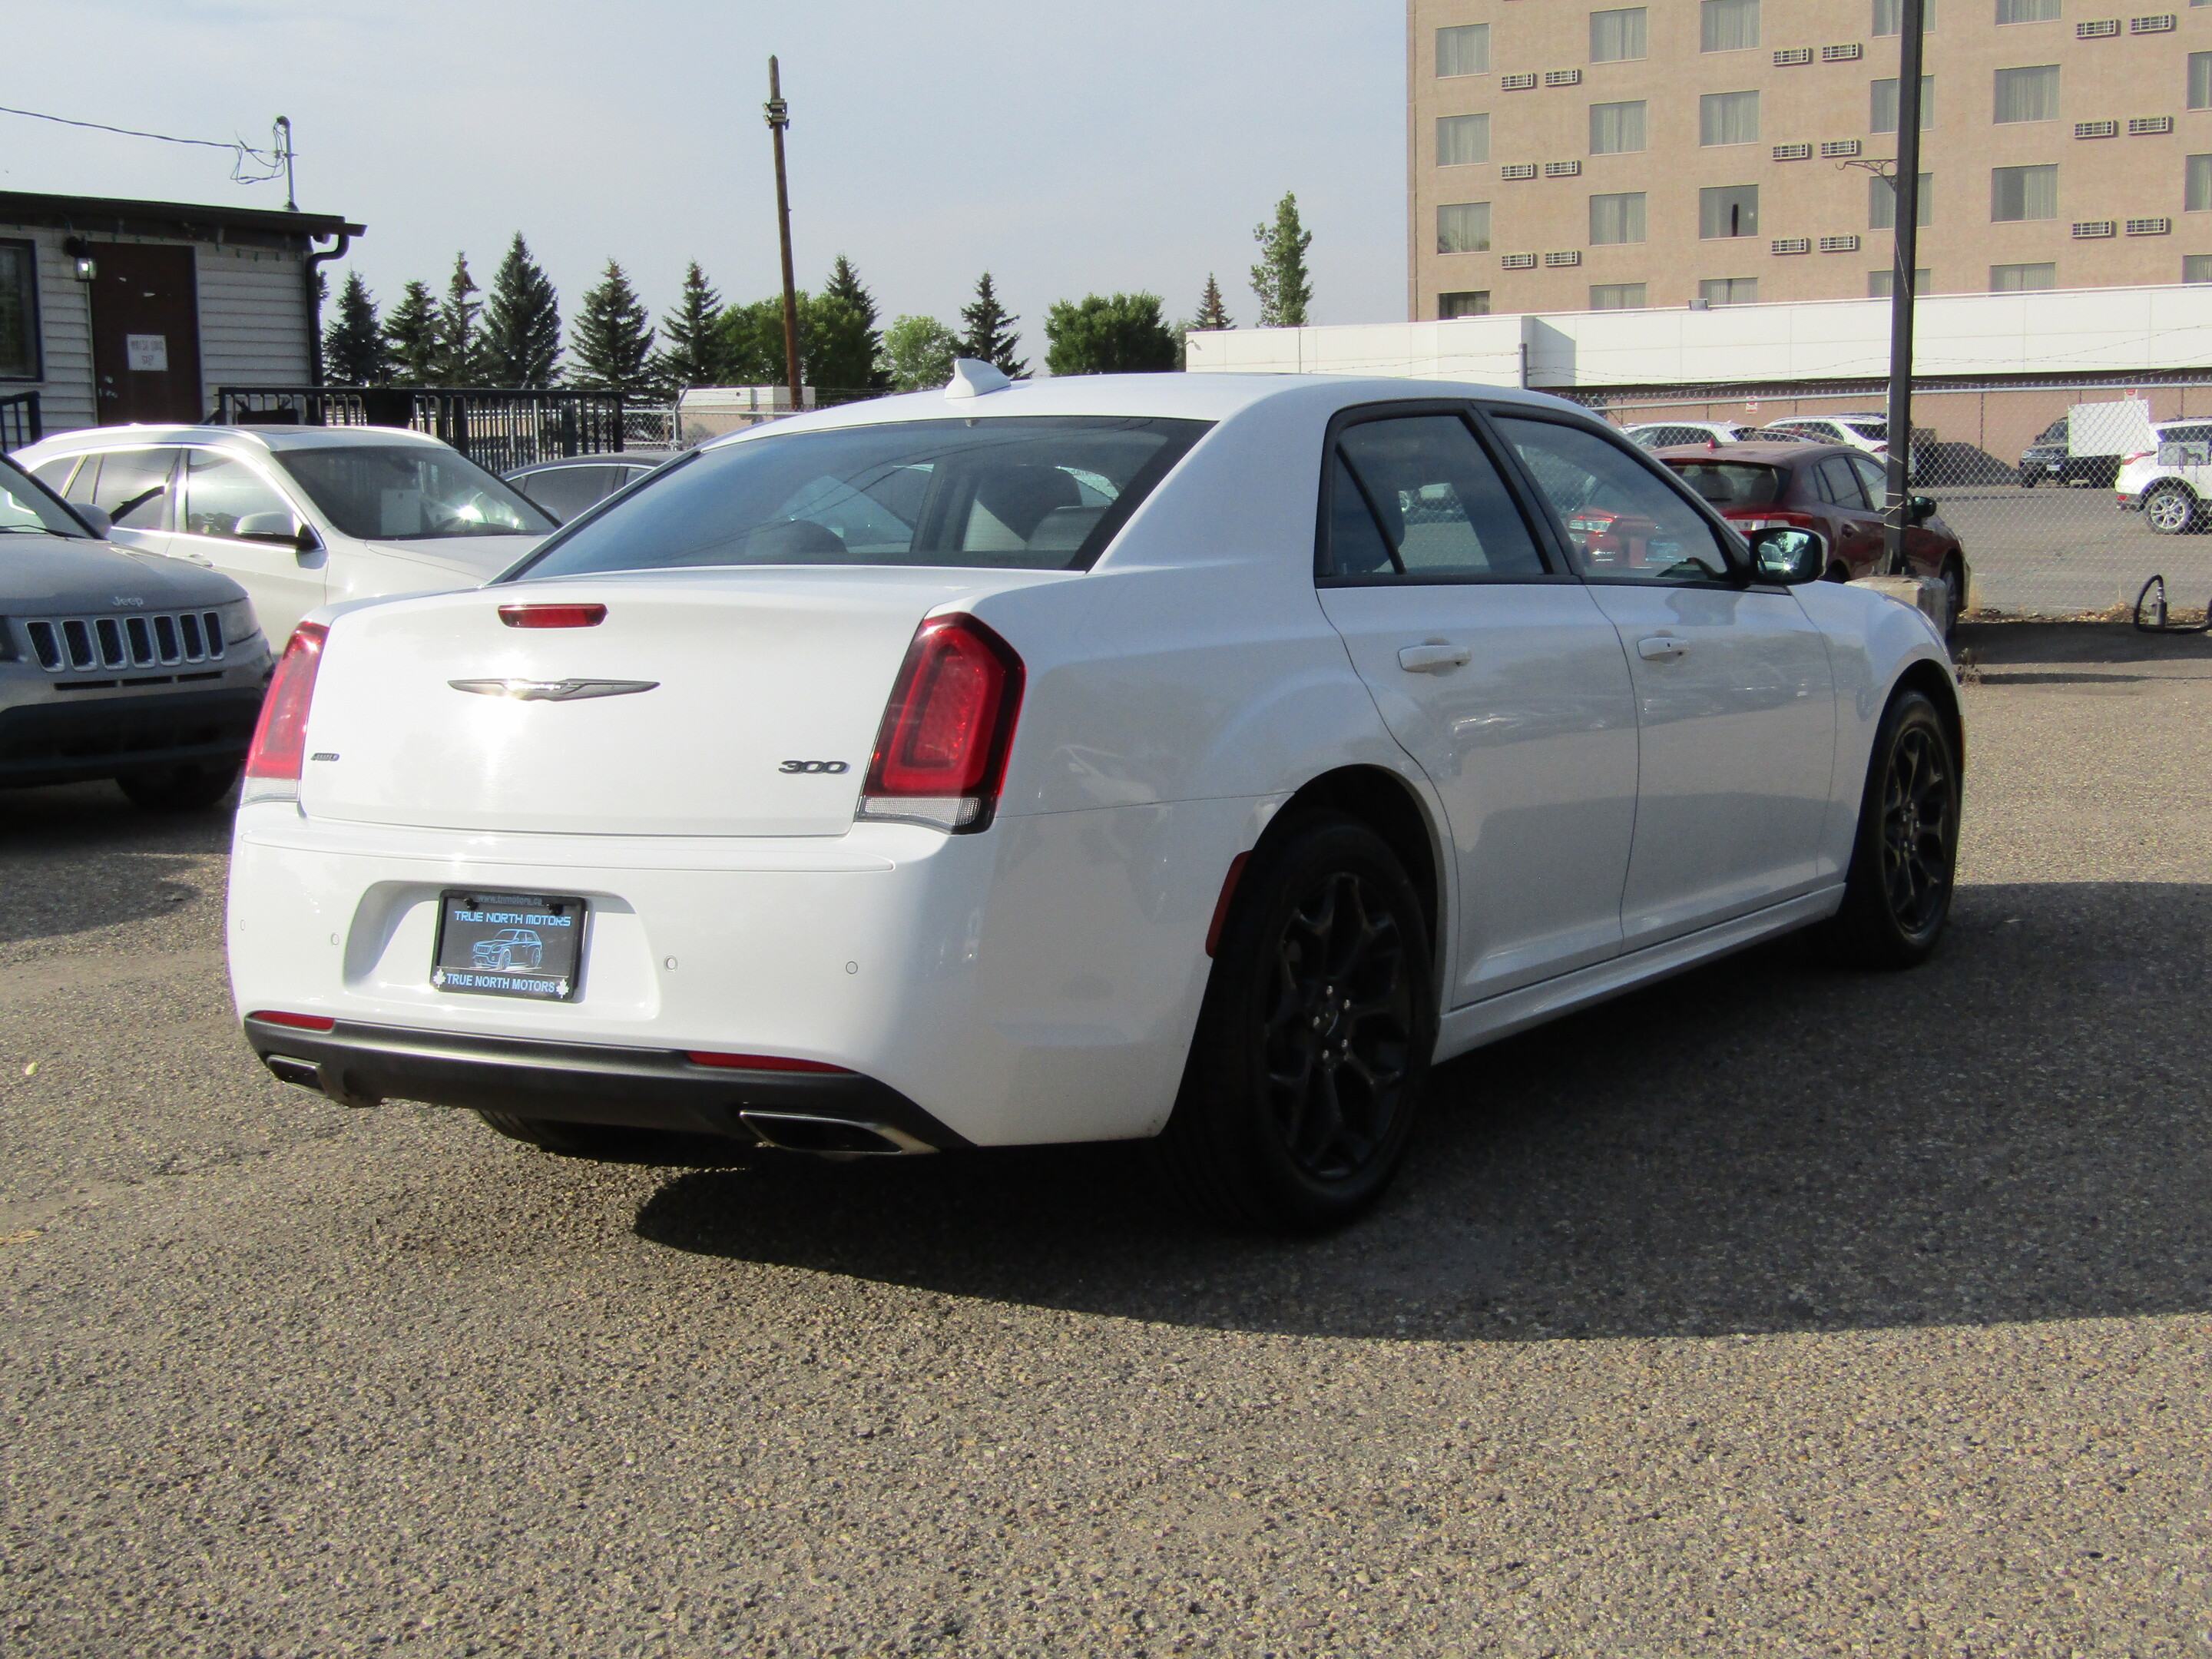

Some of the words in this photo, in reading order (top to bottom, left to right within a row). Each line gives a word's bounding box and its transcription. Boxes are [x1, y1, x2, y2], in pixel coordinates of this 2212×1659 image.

[112, 596, 144, 608] Jeep
[778, 760, 850, 774] 300
[455, 911, 484, 922] TRUE
[486, 912, 523, 924] NORTH
[526, 914, 571, 927] MOTORS
[447, 972, 473, 987] TRUE
[475, 975, 510, 990] NORTH
[512, 978, 555, 993] MOTORS
